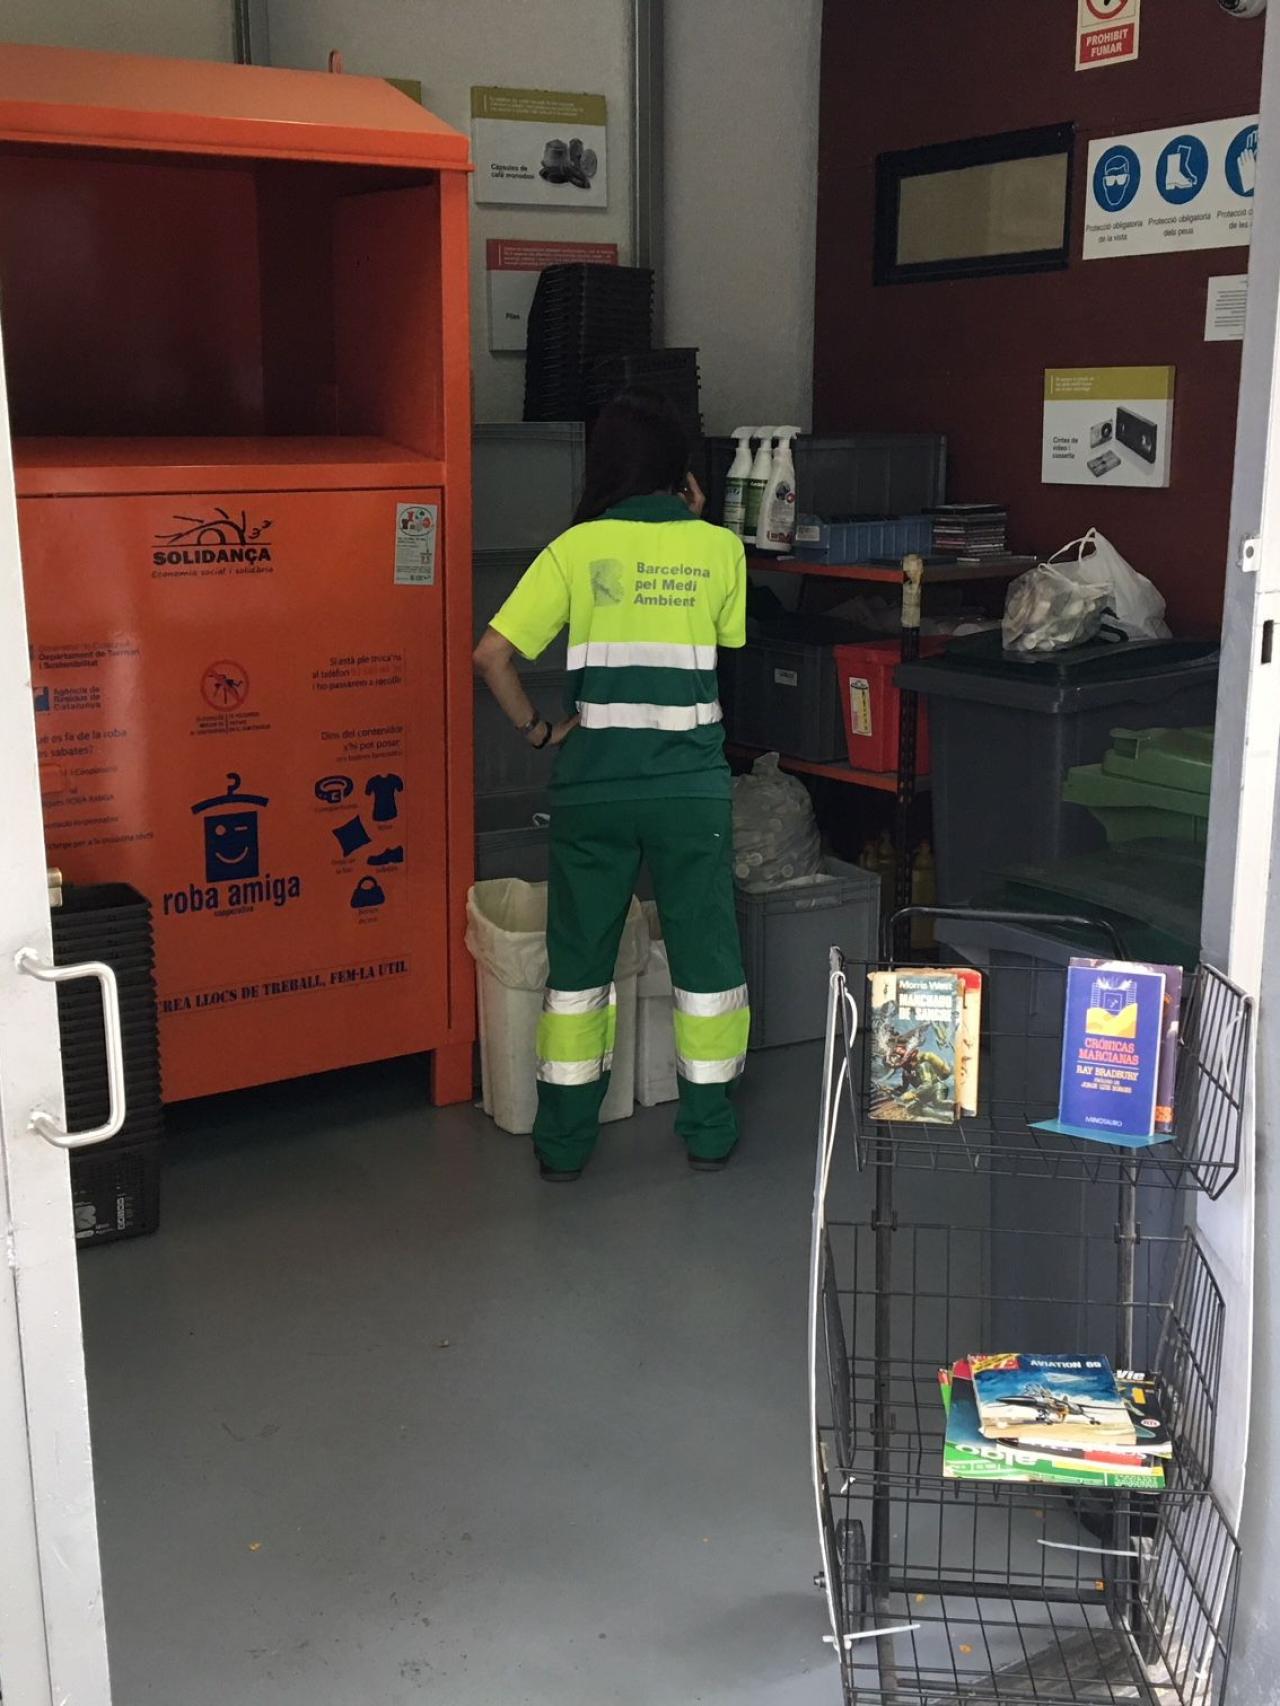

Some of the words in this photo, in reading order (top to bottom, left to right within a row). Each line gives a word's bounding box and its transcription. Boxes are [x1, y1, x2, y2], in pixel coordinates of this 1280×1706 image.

[1086, 28, 1128, 47] PROHIBIT
[1091, 41, 1122, 57] FUMAR
[153, 548, 271, 565] SOLIDANÇA
[636, 562, 710, 578] Barcelona
[635, 579, 656, 591] pel
[662, 579, 697, 592] Medi
[634, 593, 695, 608] Ambient
[77, 731, 89, 741] de
[92, 730, 101, 739] la
[376, 739, 400, 750] posar
[164, 883, 218, 915] roba
[228, 874, 300, 907] amiga
[929, 981, 953, 991] West
[158, 997, 191, 1013] REA
[195, 989, 238, 1008] LLOCS
[242, 986, 259, 999] DE
[1078, 1048, 1139, 1065] MARCIANAS
[1076, 1065, 1093, 1075] RAY
[1095, 1067, 1139, 1081] BRADBURY
[1030, 1359, 1081, 1369] AVIATION
